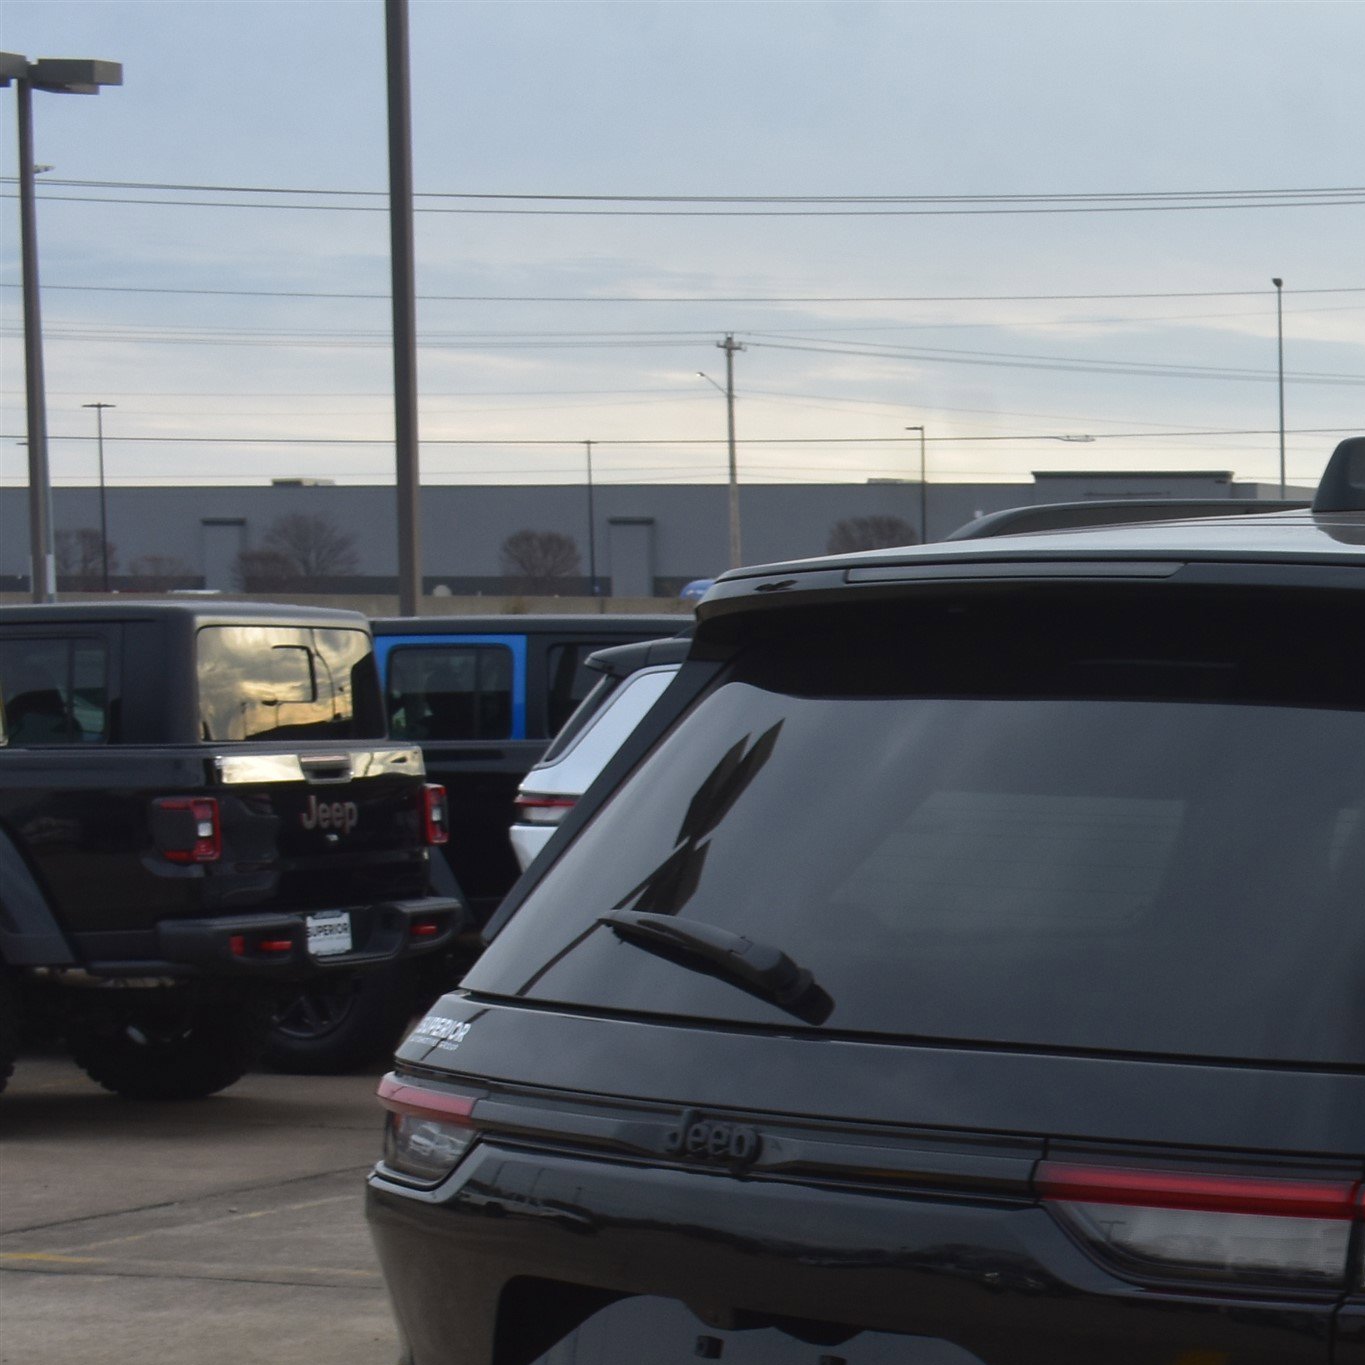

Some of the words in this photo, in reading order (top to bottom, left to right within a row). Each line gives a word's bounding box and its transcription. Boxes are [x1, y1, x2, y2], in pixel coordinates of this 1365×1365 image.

[301, 794, 358, 834] Jeep
[306, 922, 349, 938] SUPERIOR
[416, 1016, 472, 1043] SUPERIOR
[663, 1108, 761, 1172] Jeep
